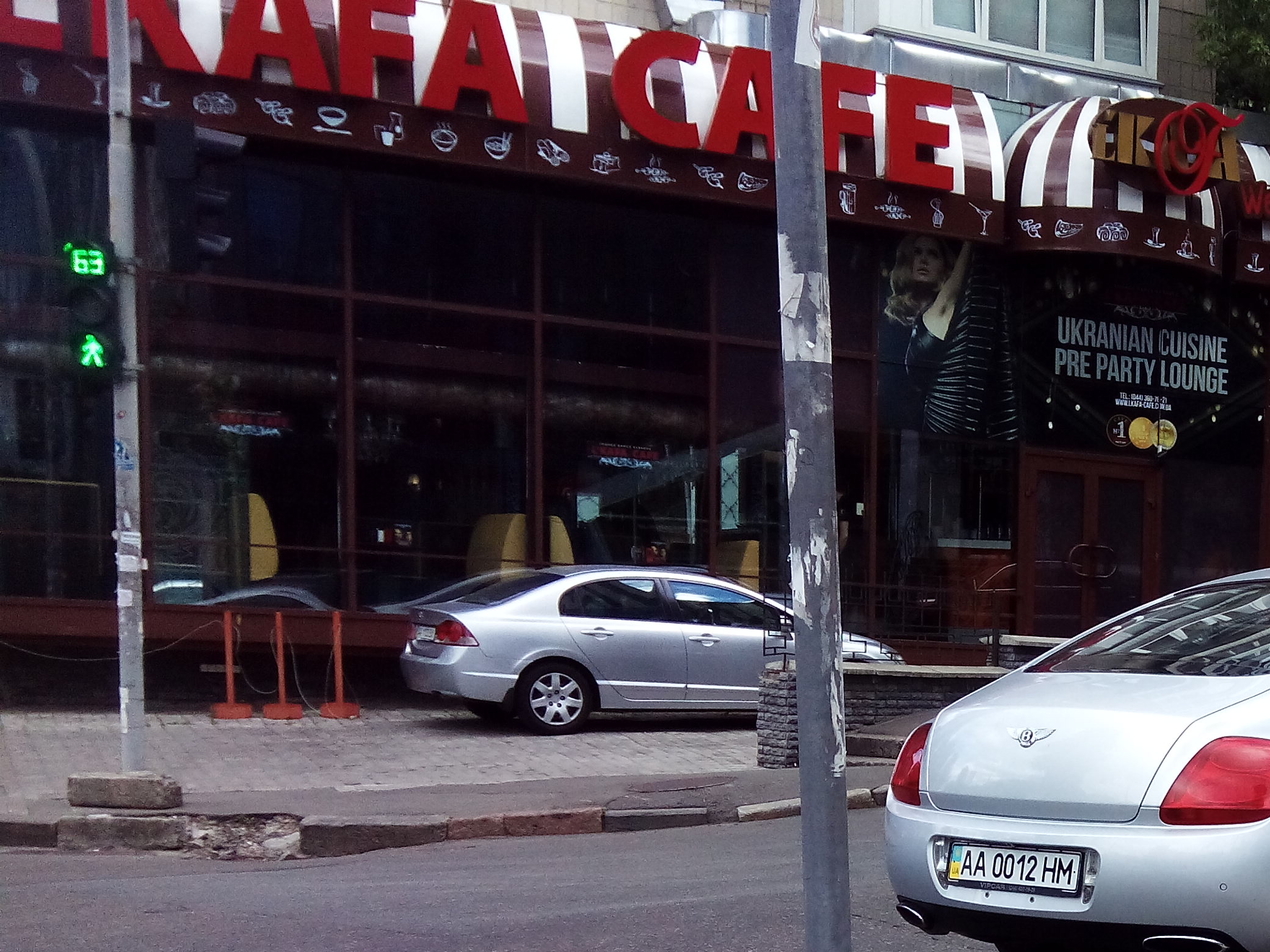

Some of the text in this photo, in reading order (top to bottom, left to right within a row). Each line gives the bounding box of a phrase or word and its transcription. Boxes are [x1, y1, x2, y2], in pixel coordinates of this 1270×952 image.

[612, 30, 954, 190] CAFE
[72, 249, 105, 275] 63
[1057, 315, 1229, 364] UKRANIAN CUISINE
[1054, 347, 1230, 395] PRE PARTY LOUNGE
[960, 849, 1075, 886] AA 0012 HM
